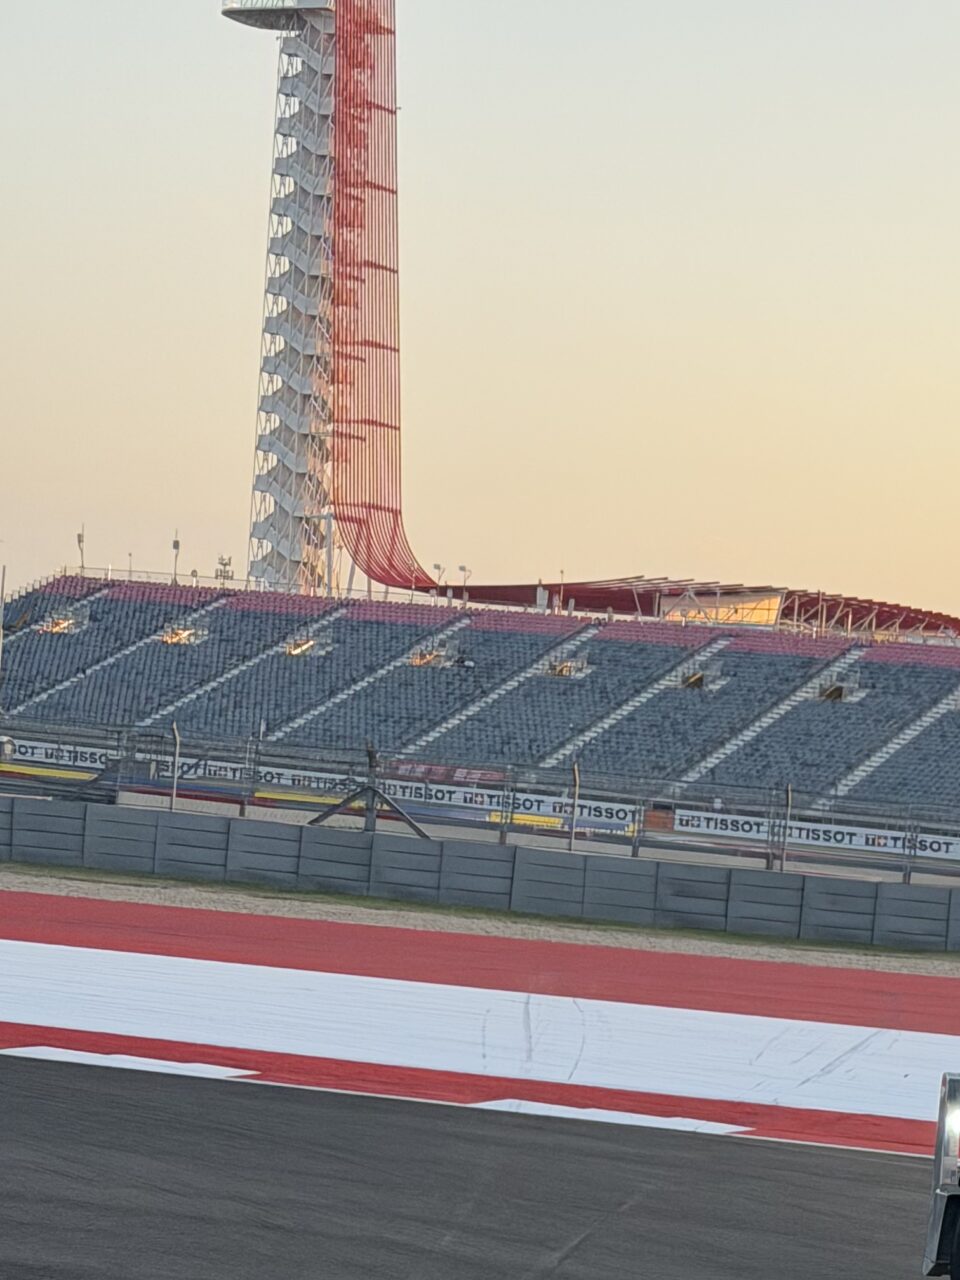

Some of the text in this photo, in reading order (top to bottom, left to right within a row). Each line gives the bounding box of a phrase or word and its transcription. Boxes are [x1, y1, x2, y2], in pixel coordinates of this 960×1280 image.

[65, 749, 109, 765] TISSO
[400, 785, 456, 802] TISSOT
[577, 804, 636, 821] TISSOT
[704, 816, 764, 833] TISSOT
[794, 826, 856, 844] TISSOT
